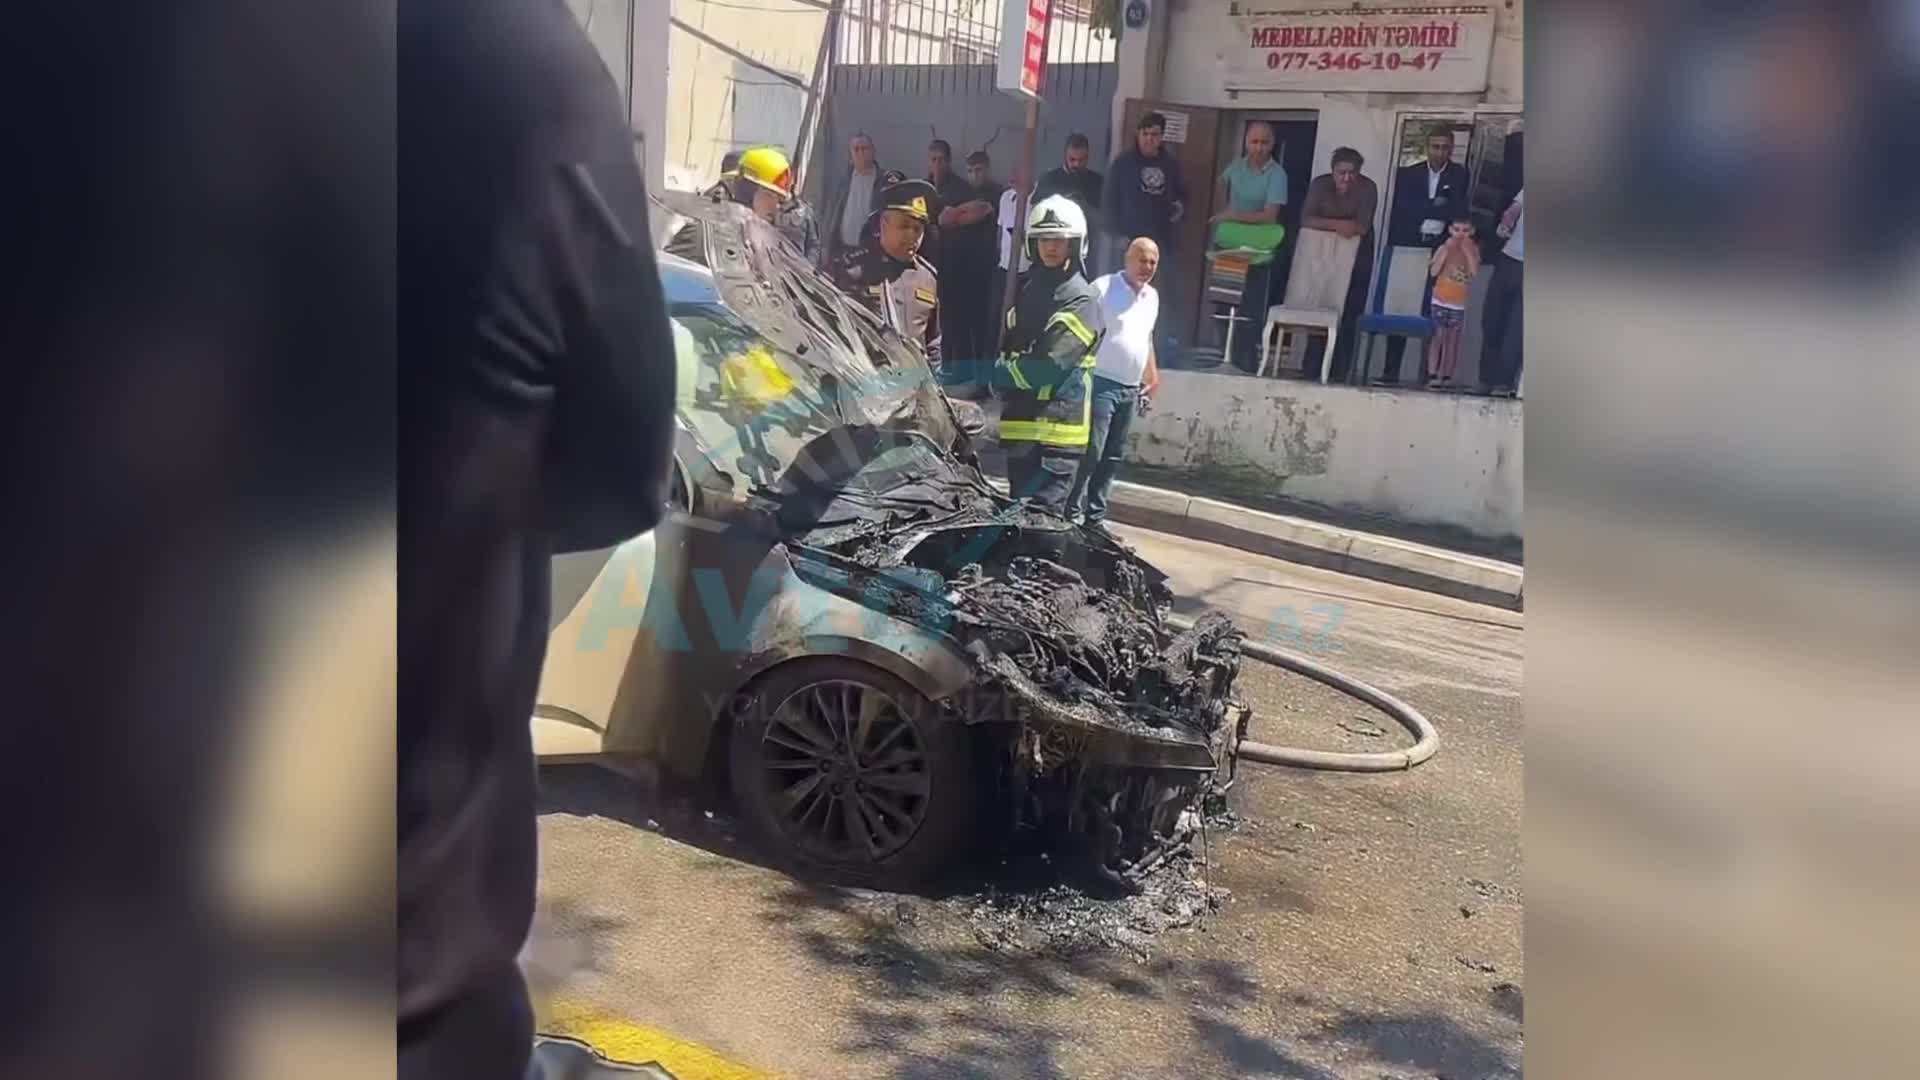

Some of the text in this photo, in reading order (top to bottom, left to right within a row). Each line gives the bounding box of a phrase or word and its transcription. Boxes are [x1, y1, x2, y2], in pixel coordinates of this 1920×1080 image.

[1251, 21, 1459, 48] MEBELLƏRİN TƏMİRİ
[1267, 52, 1442, 71] 077-346-10-47
